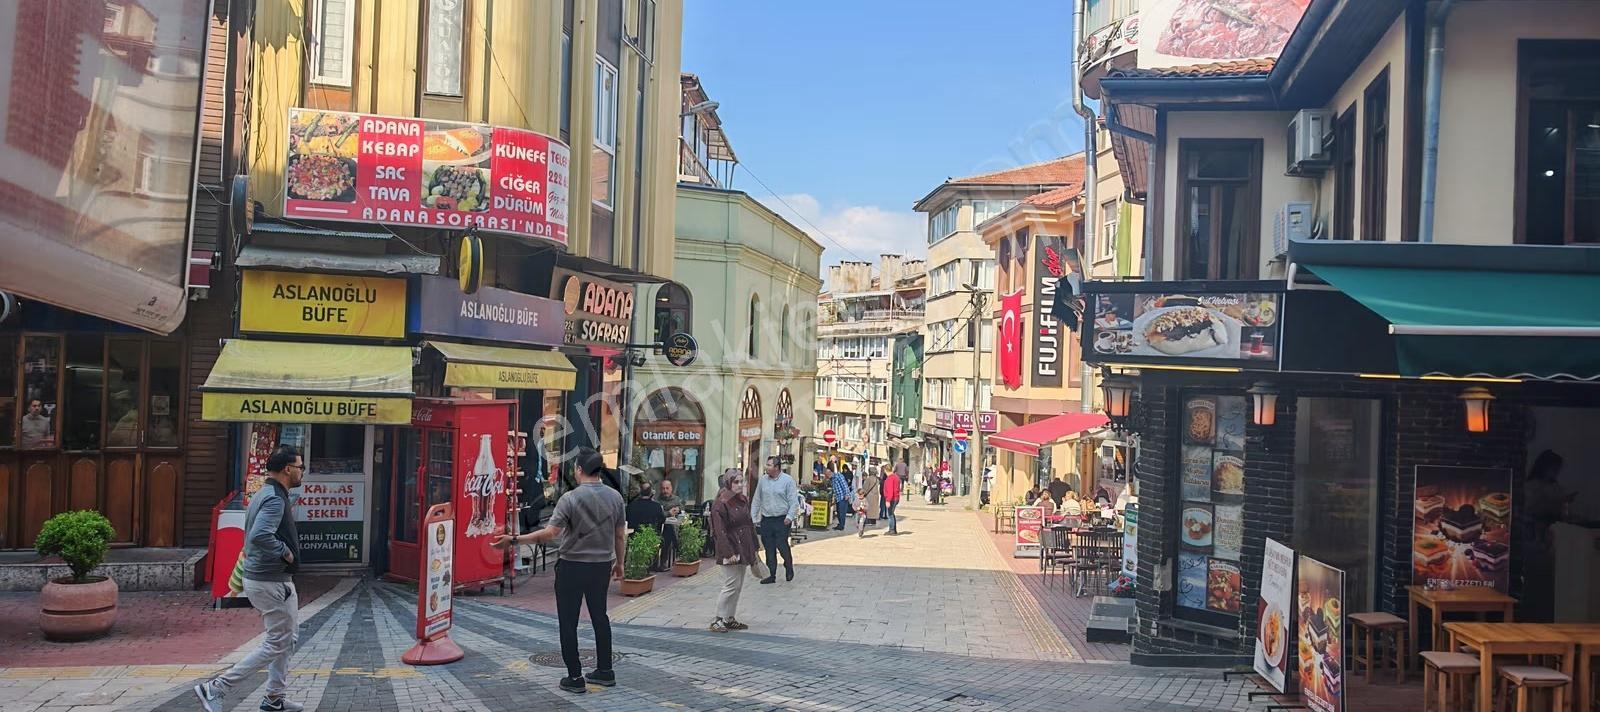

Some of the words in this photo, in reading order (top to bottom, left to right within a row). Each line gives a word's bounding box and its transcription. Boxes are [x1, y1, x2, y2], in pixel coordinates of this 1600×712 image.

[363, 119, 421, 137] ADANA
[362, 140, 420, 158] KEBAP
[495, 142, 547, 165] KÜNEFE
[375, 165, 406, 181] SAC
[369, 186, 410, 202] TAVA
[500, 174, 541, 195] CİĞER
[493, 195, 544, 216] DÜRÜM
[362, 208, 429, 224] ADANA
[436, 212, 553, 237] SOFRASI'NDA
[273, 283, 377, 304] ASLANOĞLU
[583, 281, 634, 320] ADANA
[302, 303, 348, 323] BÜFE
[460, 299, 515, 325] ASLANOĞLU
[517, 307, 539, 328] BÜFE
[580, 320, 630, 345] SOFRASI
[240, 396, 333, 416] ASLANOĞLU
[337, 399, 377, 417] BÜFE
[642, 430, 675, 441] Otantik
[677, 430, 701, 441] Bebe
[297, 496, 355, 506] KESTANE
[306, 506, 349, 521] ŞEKERİ
